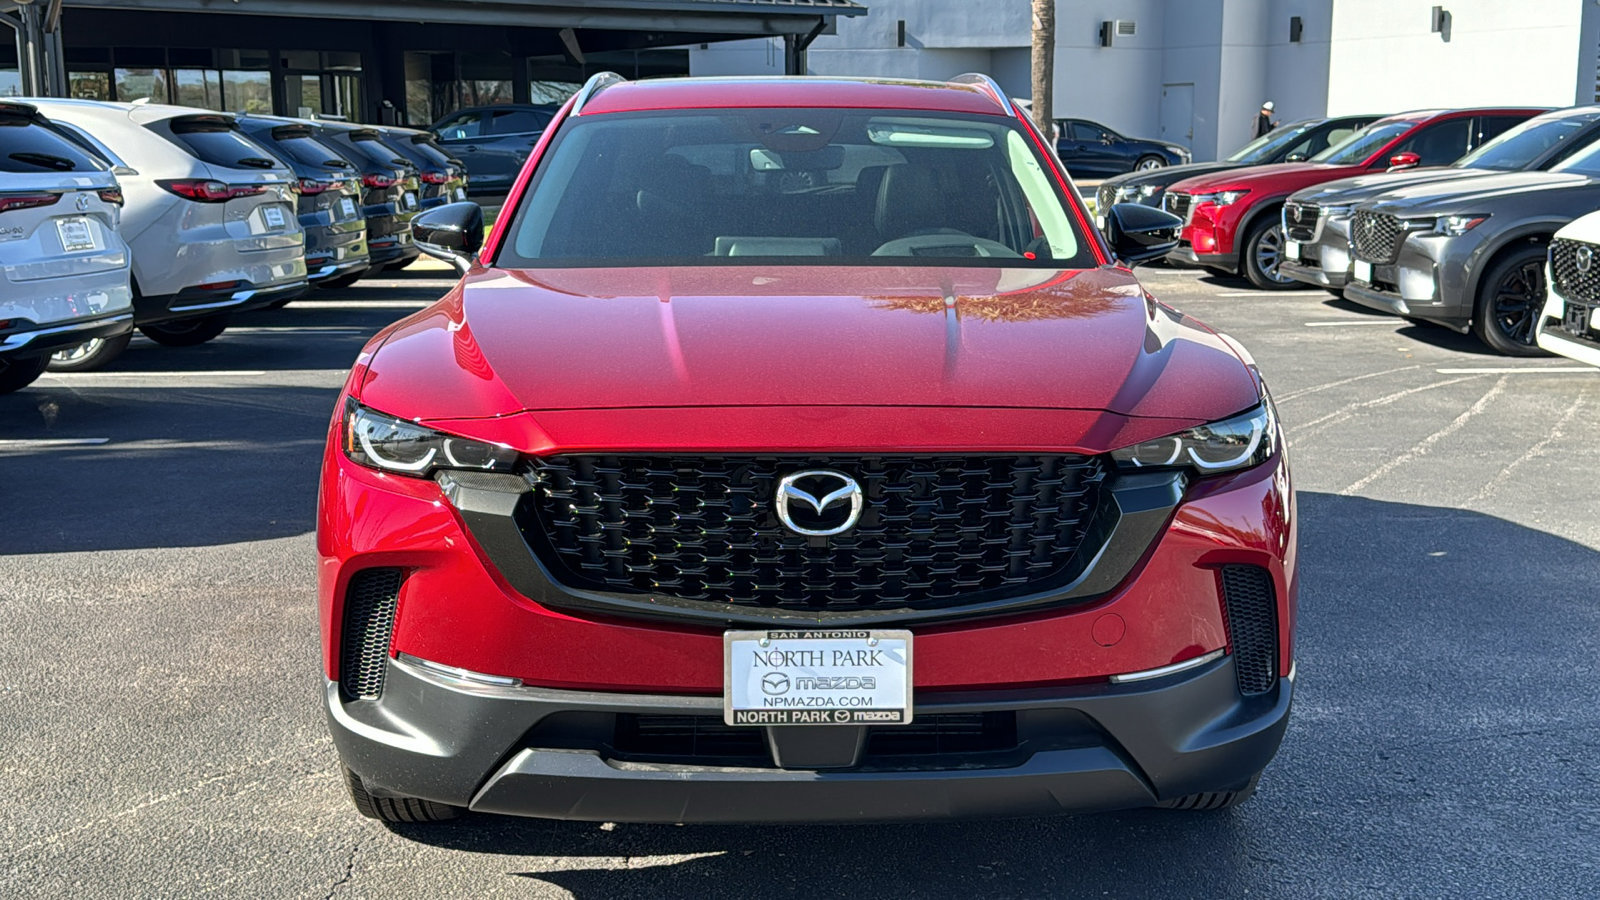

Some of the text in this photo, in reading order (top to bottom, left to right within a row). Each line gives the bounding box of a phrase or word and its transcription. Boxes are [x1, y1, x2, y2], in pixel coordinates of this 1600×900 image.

[753, 648, 883, 668] NORTH PARK
[795, 676, 876, 690] mazda
[763, 696, 873, 707] NPMAZDA.COM
[737, 711, 900, 722] NORTH PARK mazda
